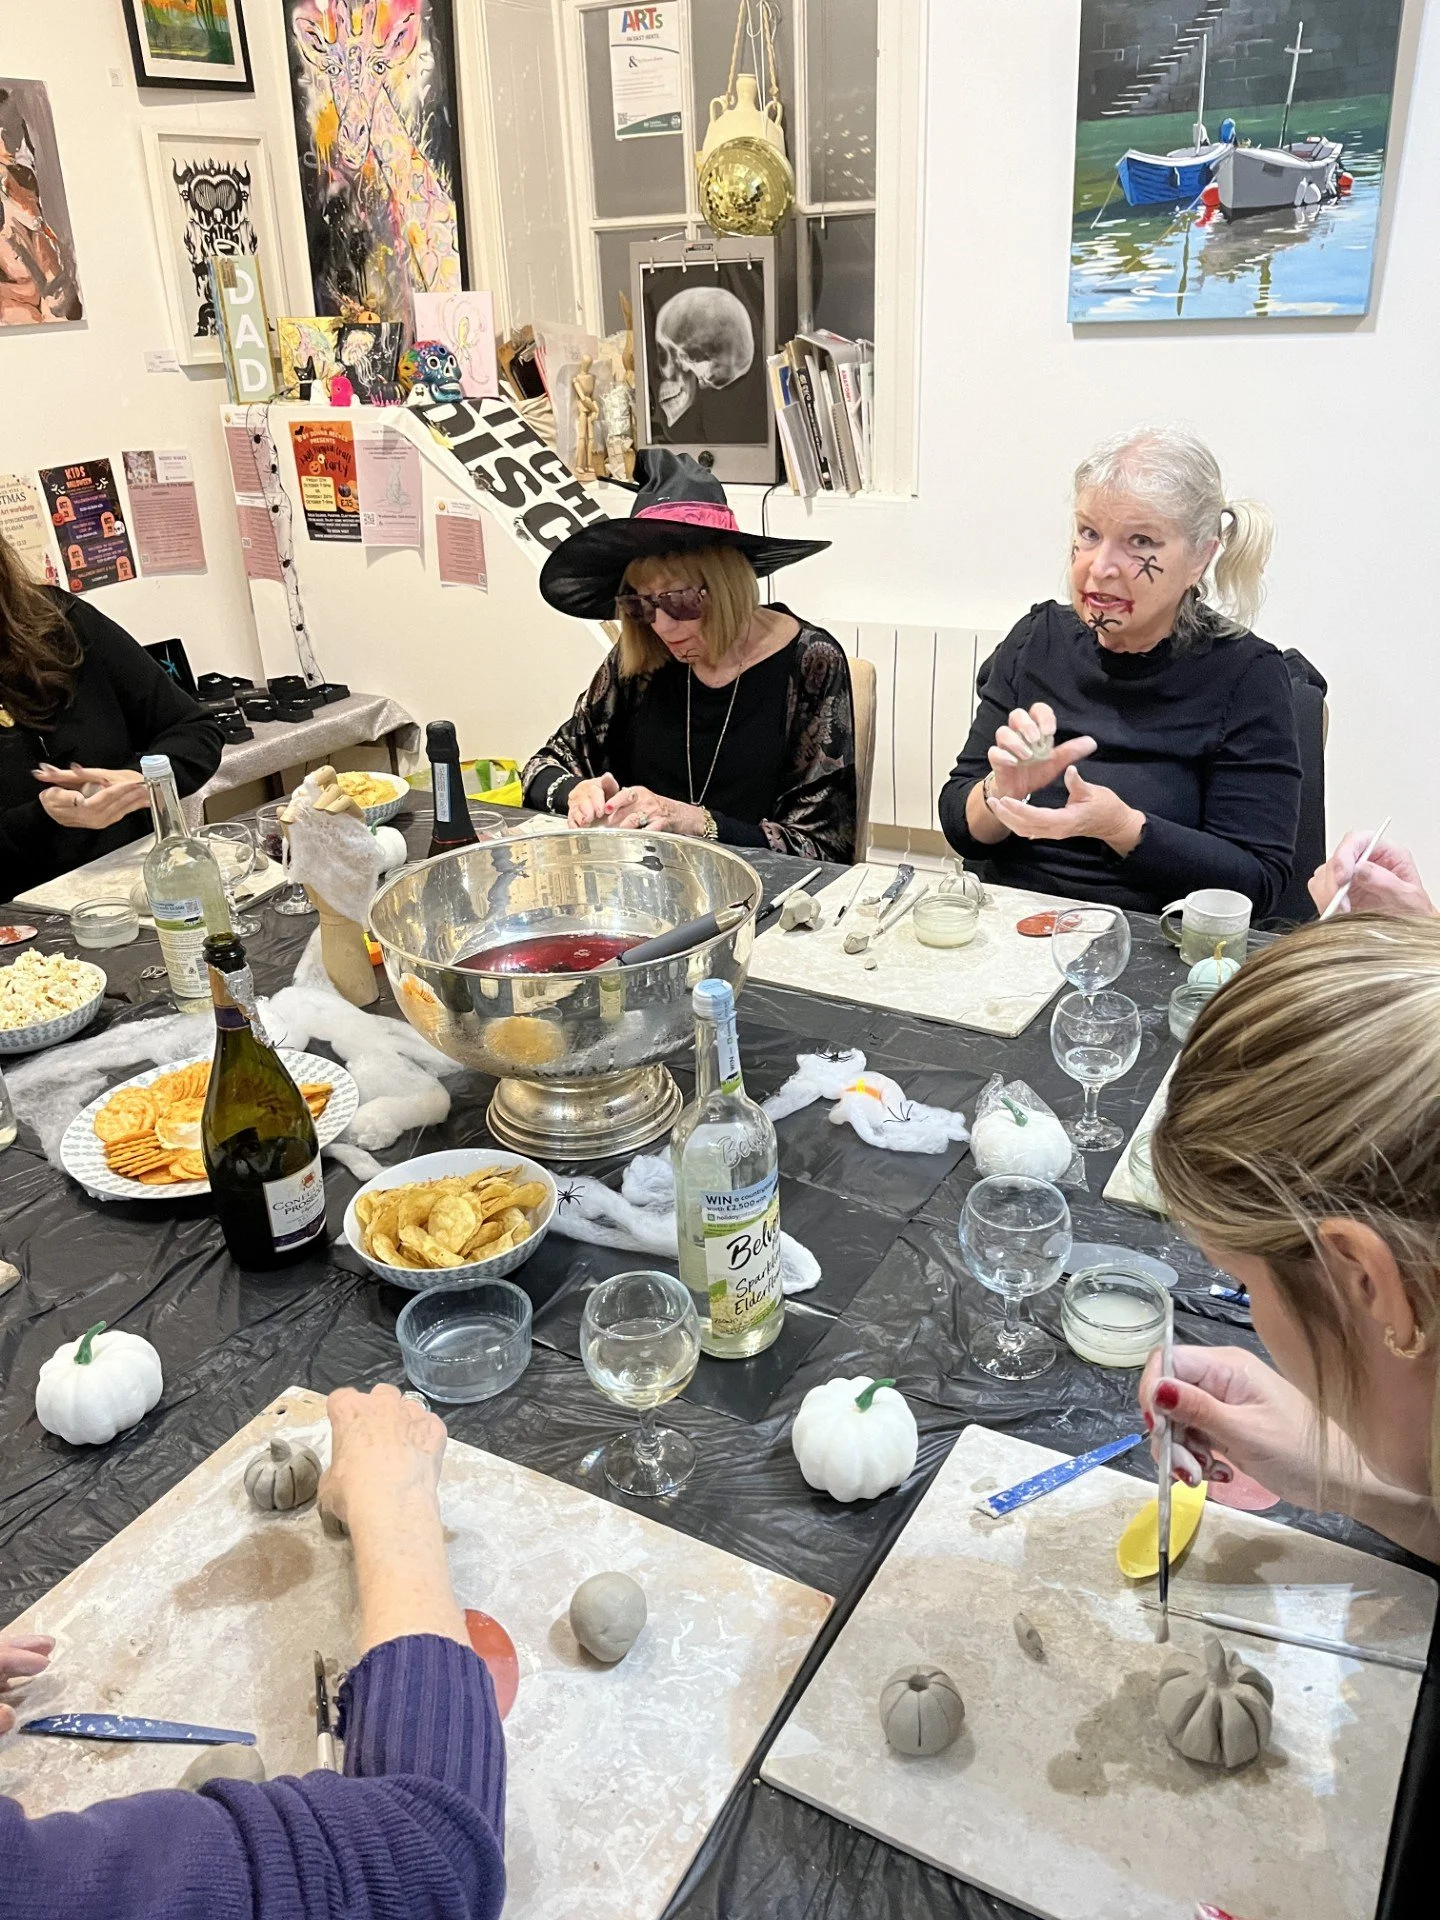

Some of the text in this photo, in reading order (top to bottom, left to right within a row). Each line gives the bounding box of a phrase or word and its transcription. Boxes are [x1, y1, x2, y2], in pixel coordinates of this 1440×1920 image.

[621, 7, 663, 33] ARTs
[228, 269, 268, 392] DAD
[64, 466, 86, 480] KIDS
[705, 1194, 733, 1206] WIN
